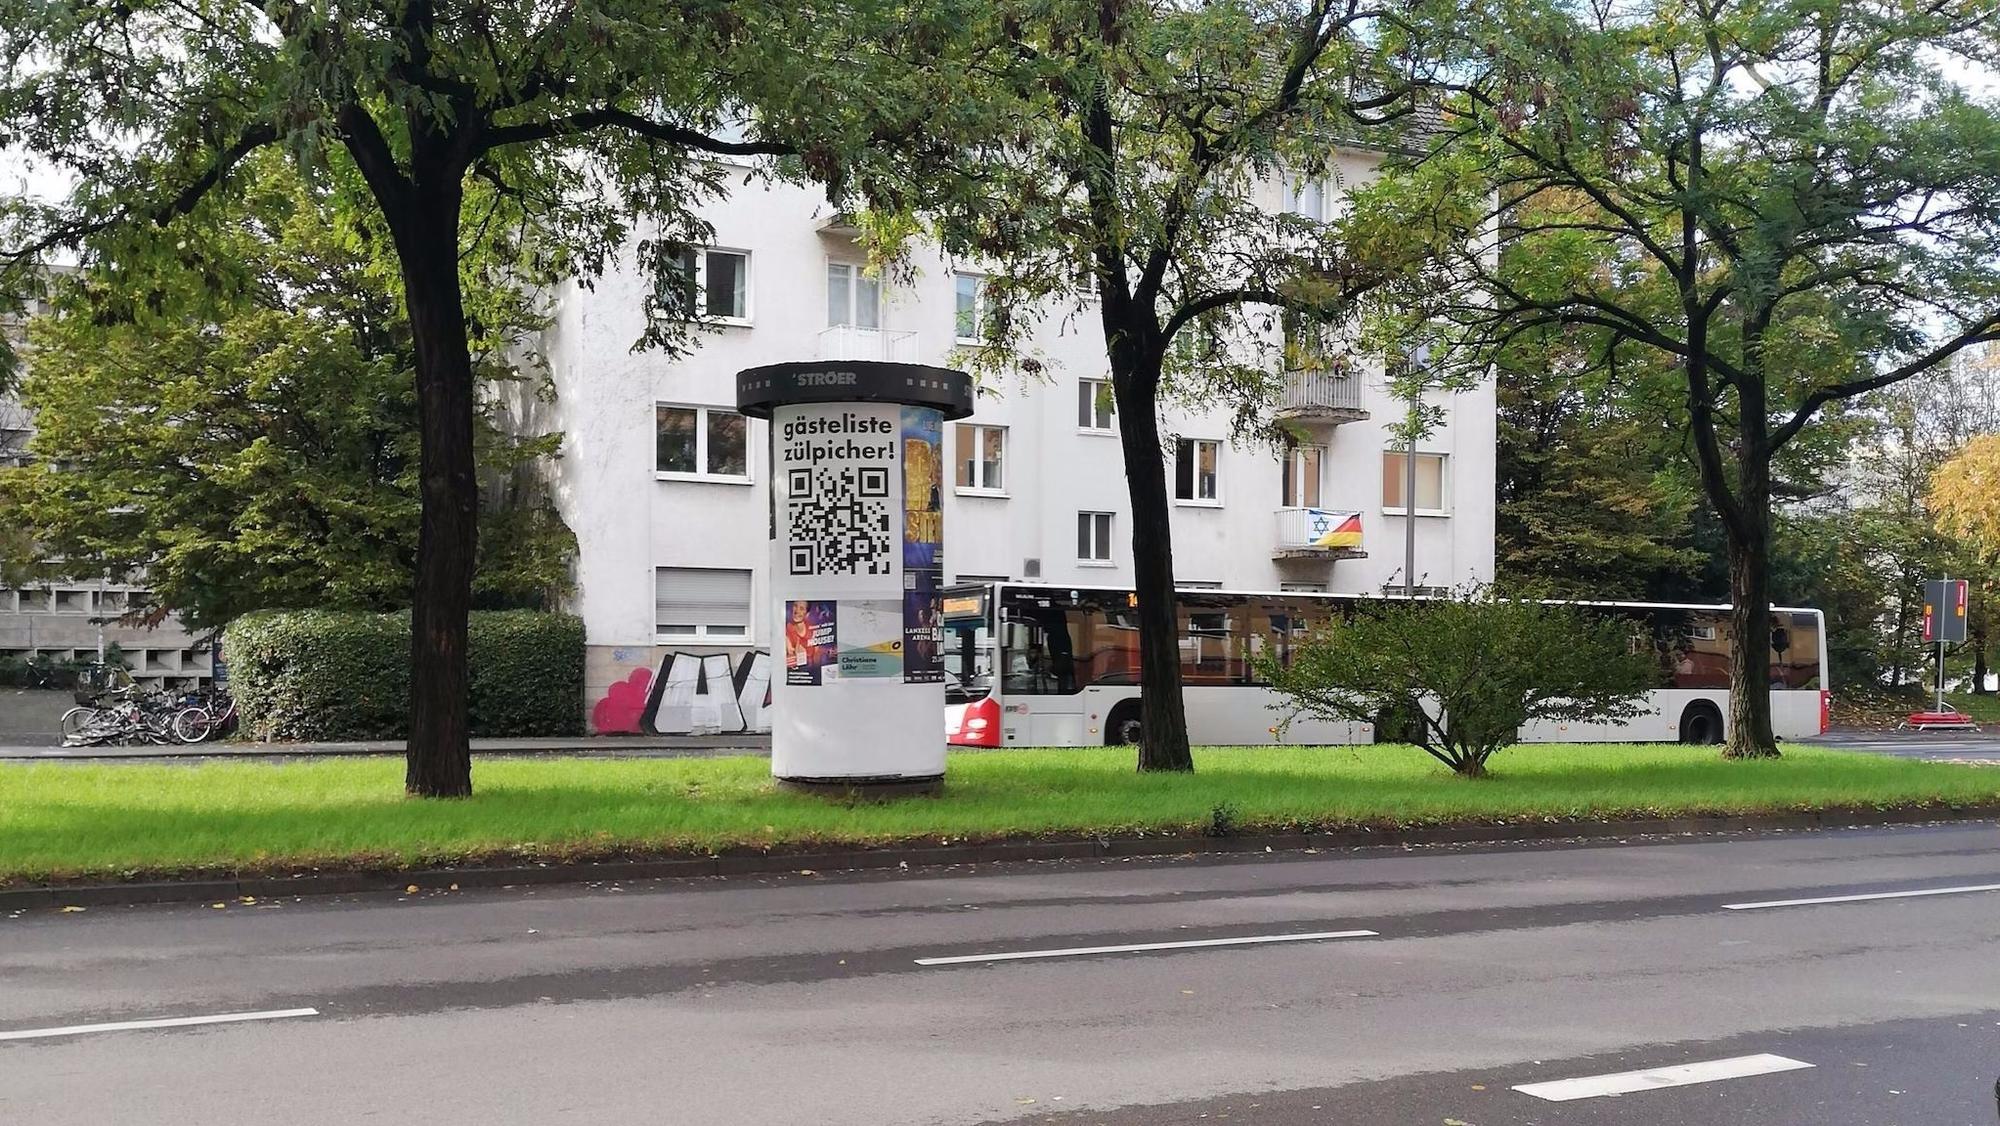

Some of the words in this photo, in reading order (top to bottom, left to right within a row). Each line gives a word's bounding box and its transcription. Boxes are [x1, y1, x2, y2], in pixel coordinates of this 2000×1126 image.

[784, 413, 892, 441] gästeliste
[784, 439, 895, 465] zülpicher!
[812, 627, 833, 638] JUMP
